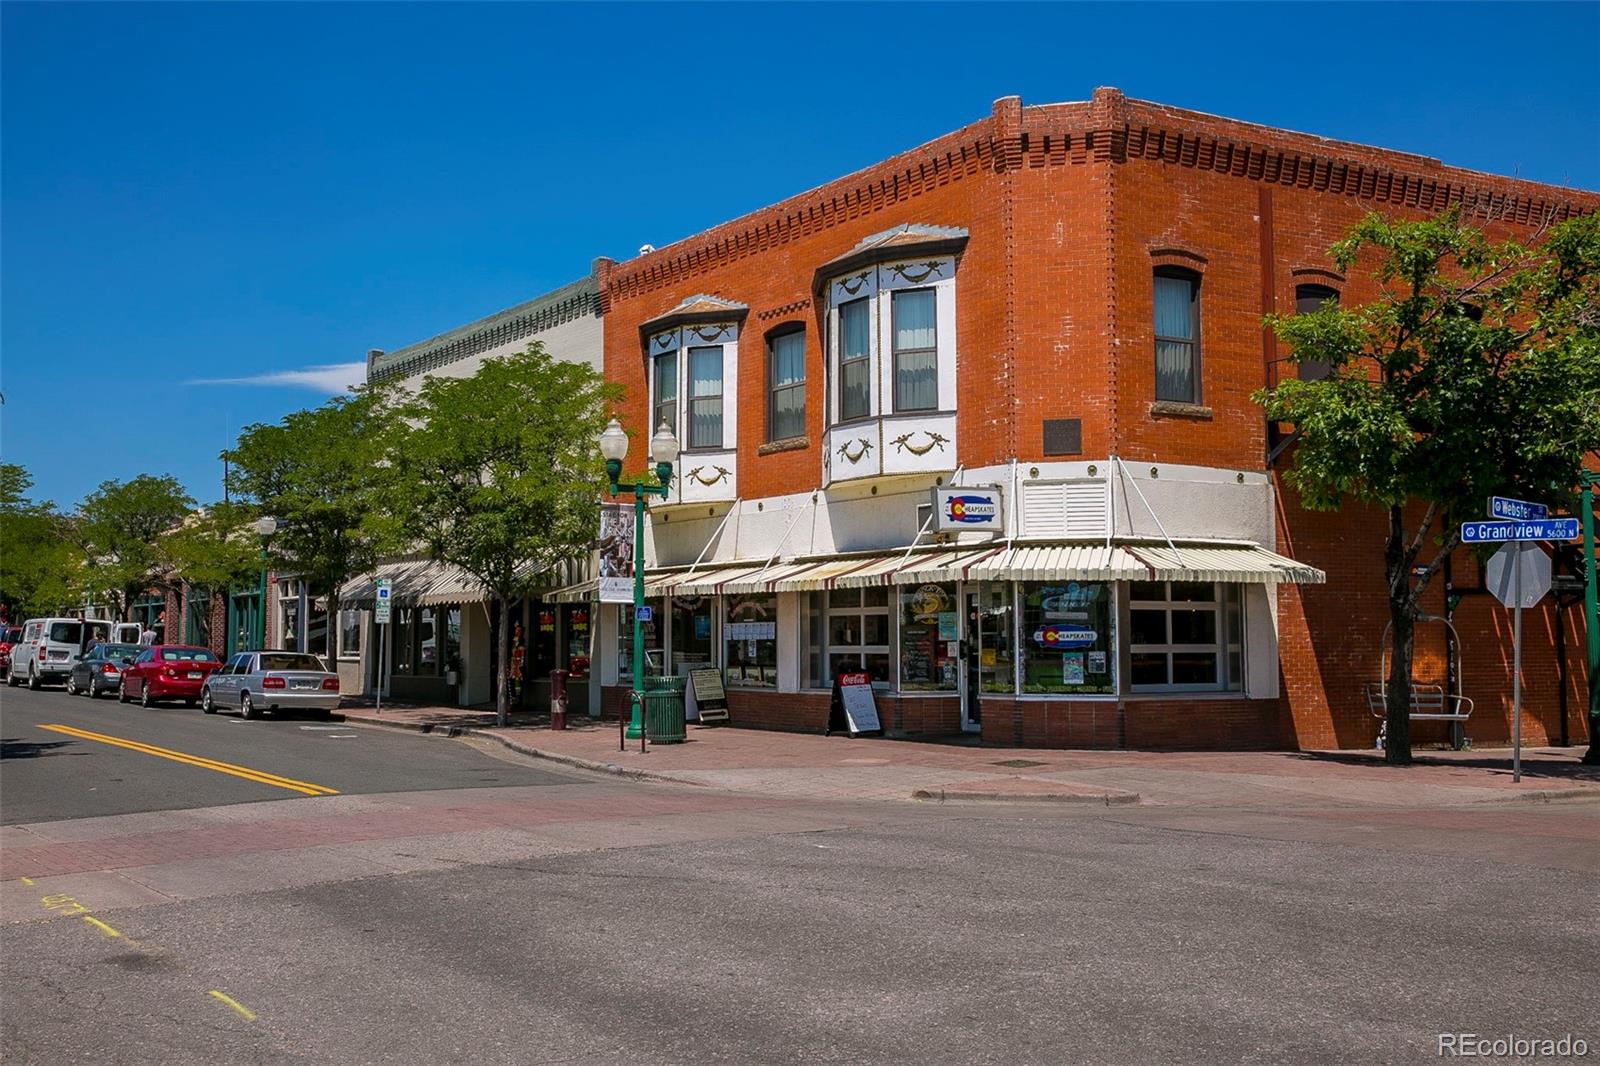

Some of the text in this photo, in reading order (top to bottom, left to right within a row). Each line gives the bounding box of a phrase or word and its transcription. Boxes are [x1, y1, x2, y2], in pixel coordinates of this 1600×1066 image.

[1501, 501, 1532, 518] Webster
[1478, 523, 1544, 539] Grandview
[1547, 529, 1574, 538] 5600 N
